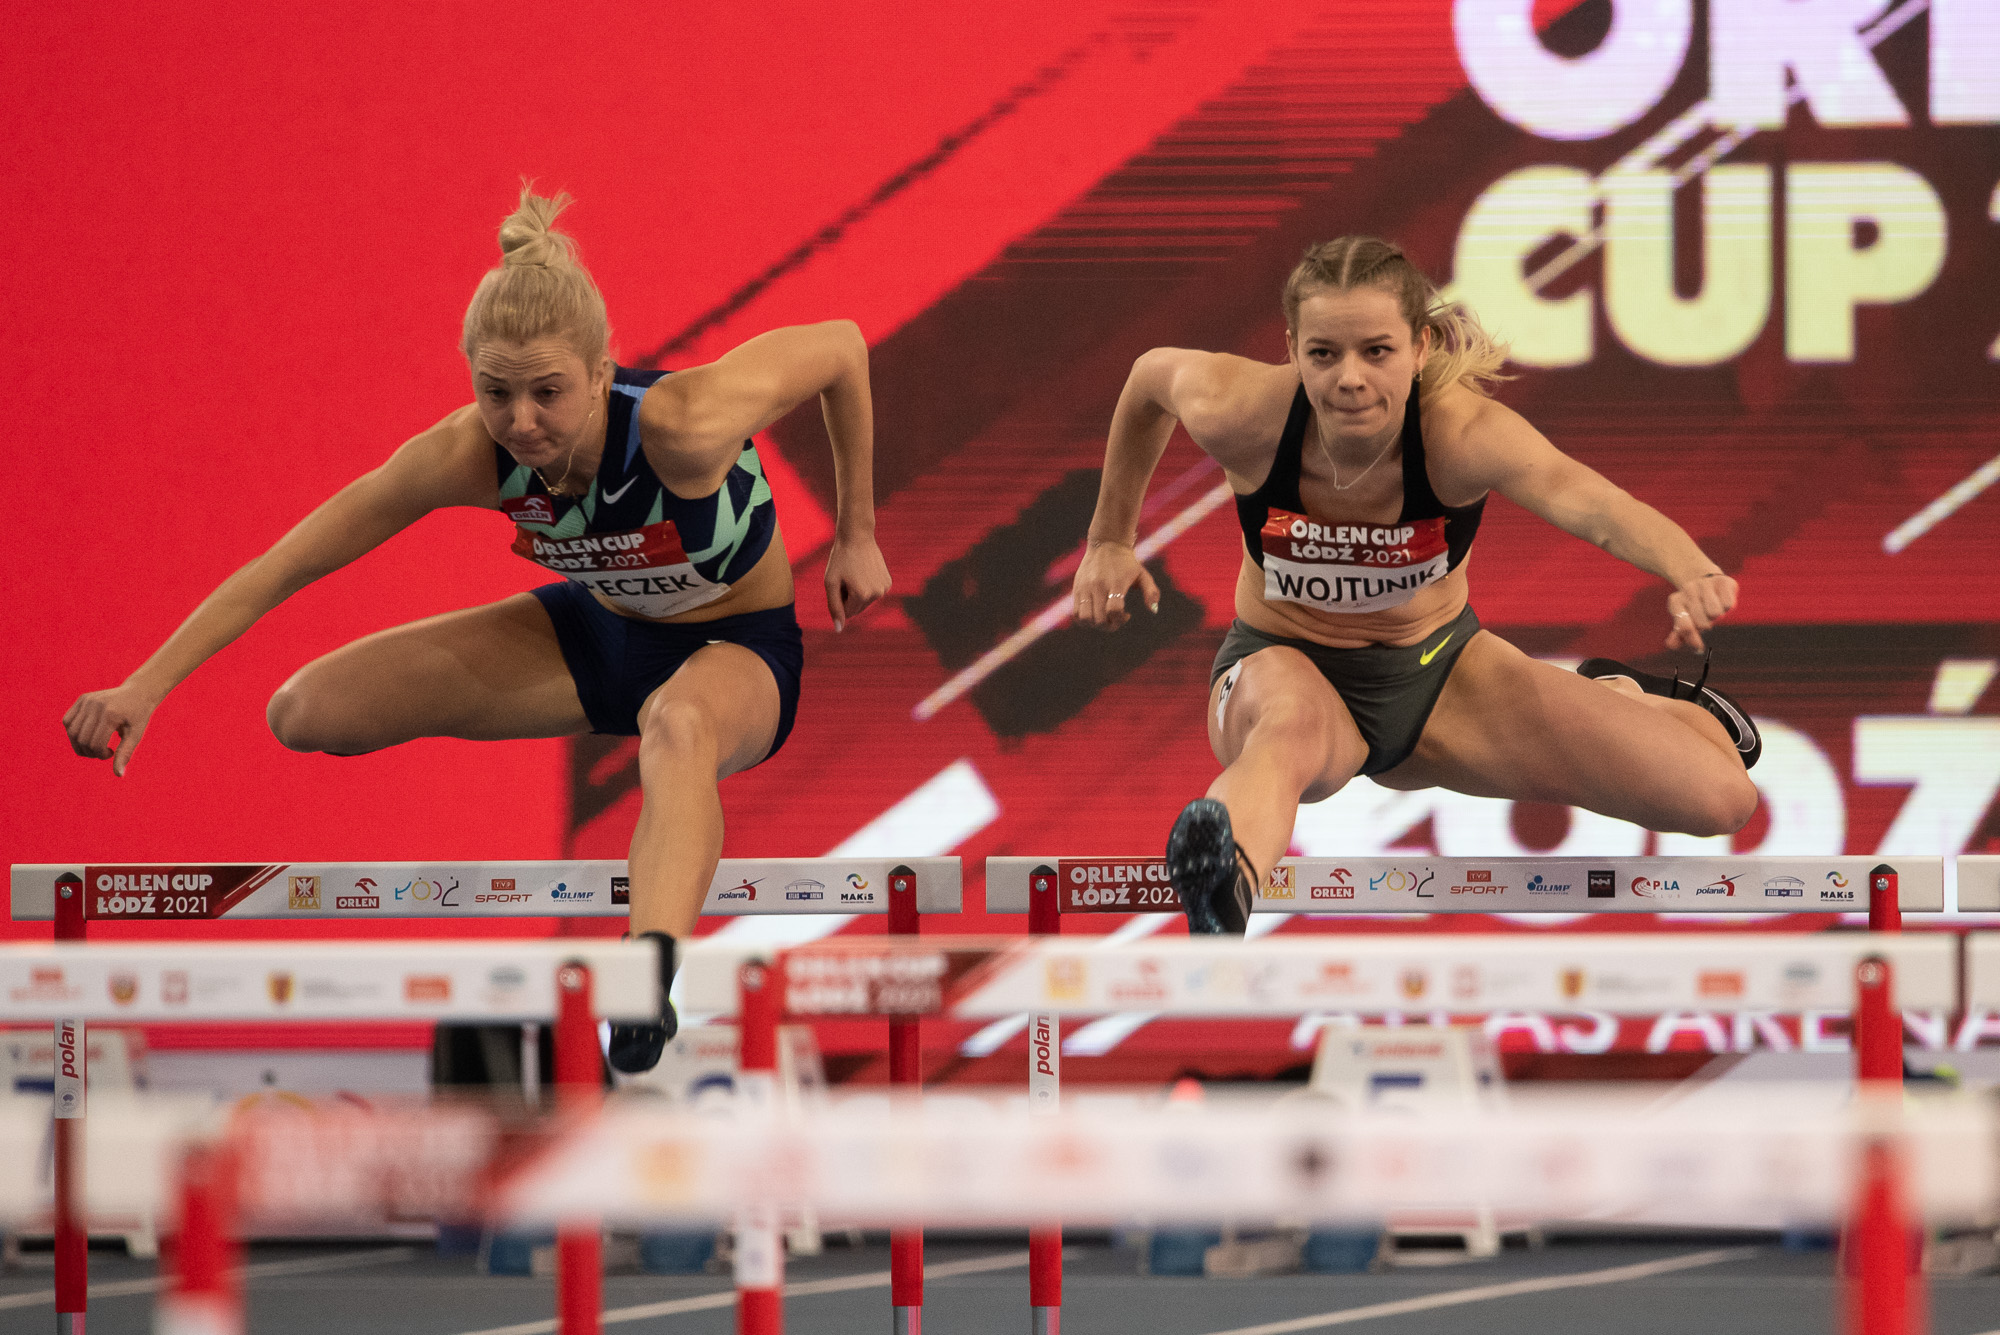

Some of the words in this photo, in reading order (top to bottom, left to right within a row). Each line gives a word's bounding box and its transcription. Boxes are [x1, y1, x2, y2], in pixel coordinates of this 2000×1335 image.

[1453, 161, 1949, 367] CUP
[1290, 519, 1367, 546] ORLEN
[1371, 526, 1415, 546] CUP
[533, 536, 602, 556] ORLEN
[602, 533, 646, 552] CUP
[1290, 542, 1355, 561] ŁÓDŹ
[1362, 548, 1412, 564] 2021
[601, 552, 650, 568] 2021
[1273, 563, 1437, 602] WOJTUNIK
[96, 874, 169, 891] ORLEN
[171, 874, 213, 891] CUP
[1070, 865, 1143, 884] ORLEN
[1145, 864, 1172, 882] CU
[475, 894, 533, 903] SPORT
[718, 891, 749, 900] polanik
[1071, 883, 1131, 906] ŁÓDŹ
[1263, 887, 1295, 898] PZLA
[1312, 888, 1353, 898] ORLEN
[1450, 886, 1508, 894] SPORT
[1695, 887, 1726, 895] polanik
[97, 892, 156, 914] ŁÓDŹ
[163, 896, 207, 913] 2021
[338, 897, 378, 908] ORLEN
[58, 1016, 79, 1079] polan
[1033, 1012, 1054, 1077] polan
